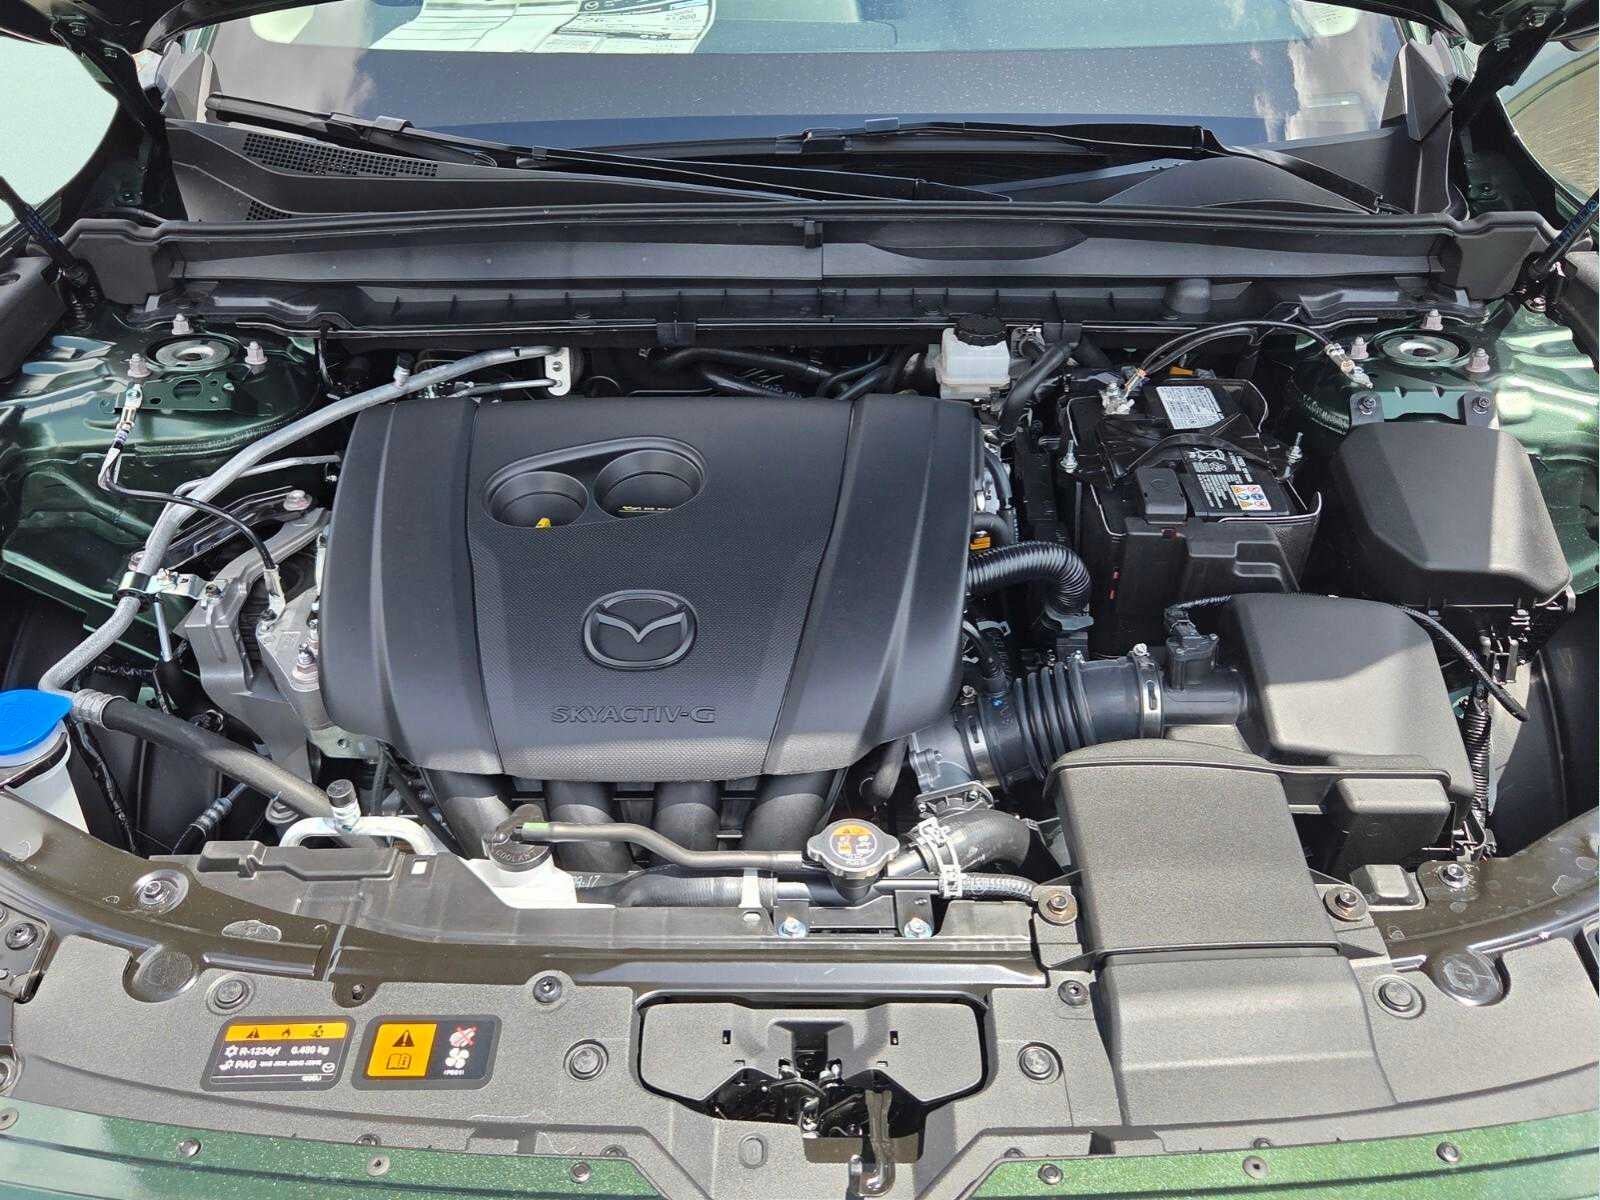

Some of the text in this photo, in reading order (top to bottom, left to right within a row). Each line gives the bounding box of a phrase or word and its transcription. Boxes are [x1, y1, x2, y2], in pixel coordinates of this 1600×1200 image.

[552, 705, 717, 723] SKYACTIV-G
[317, 1045, 330, 1056] kg
[235, 1060, 257, 1069] PAG
